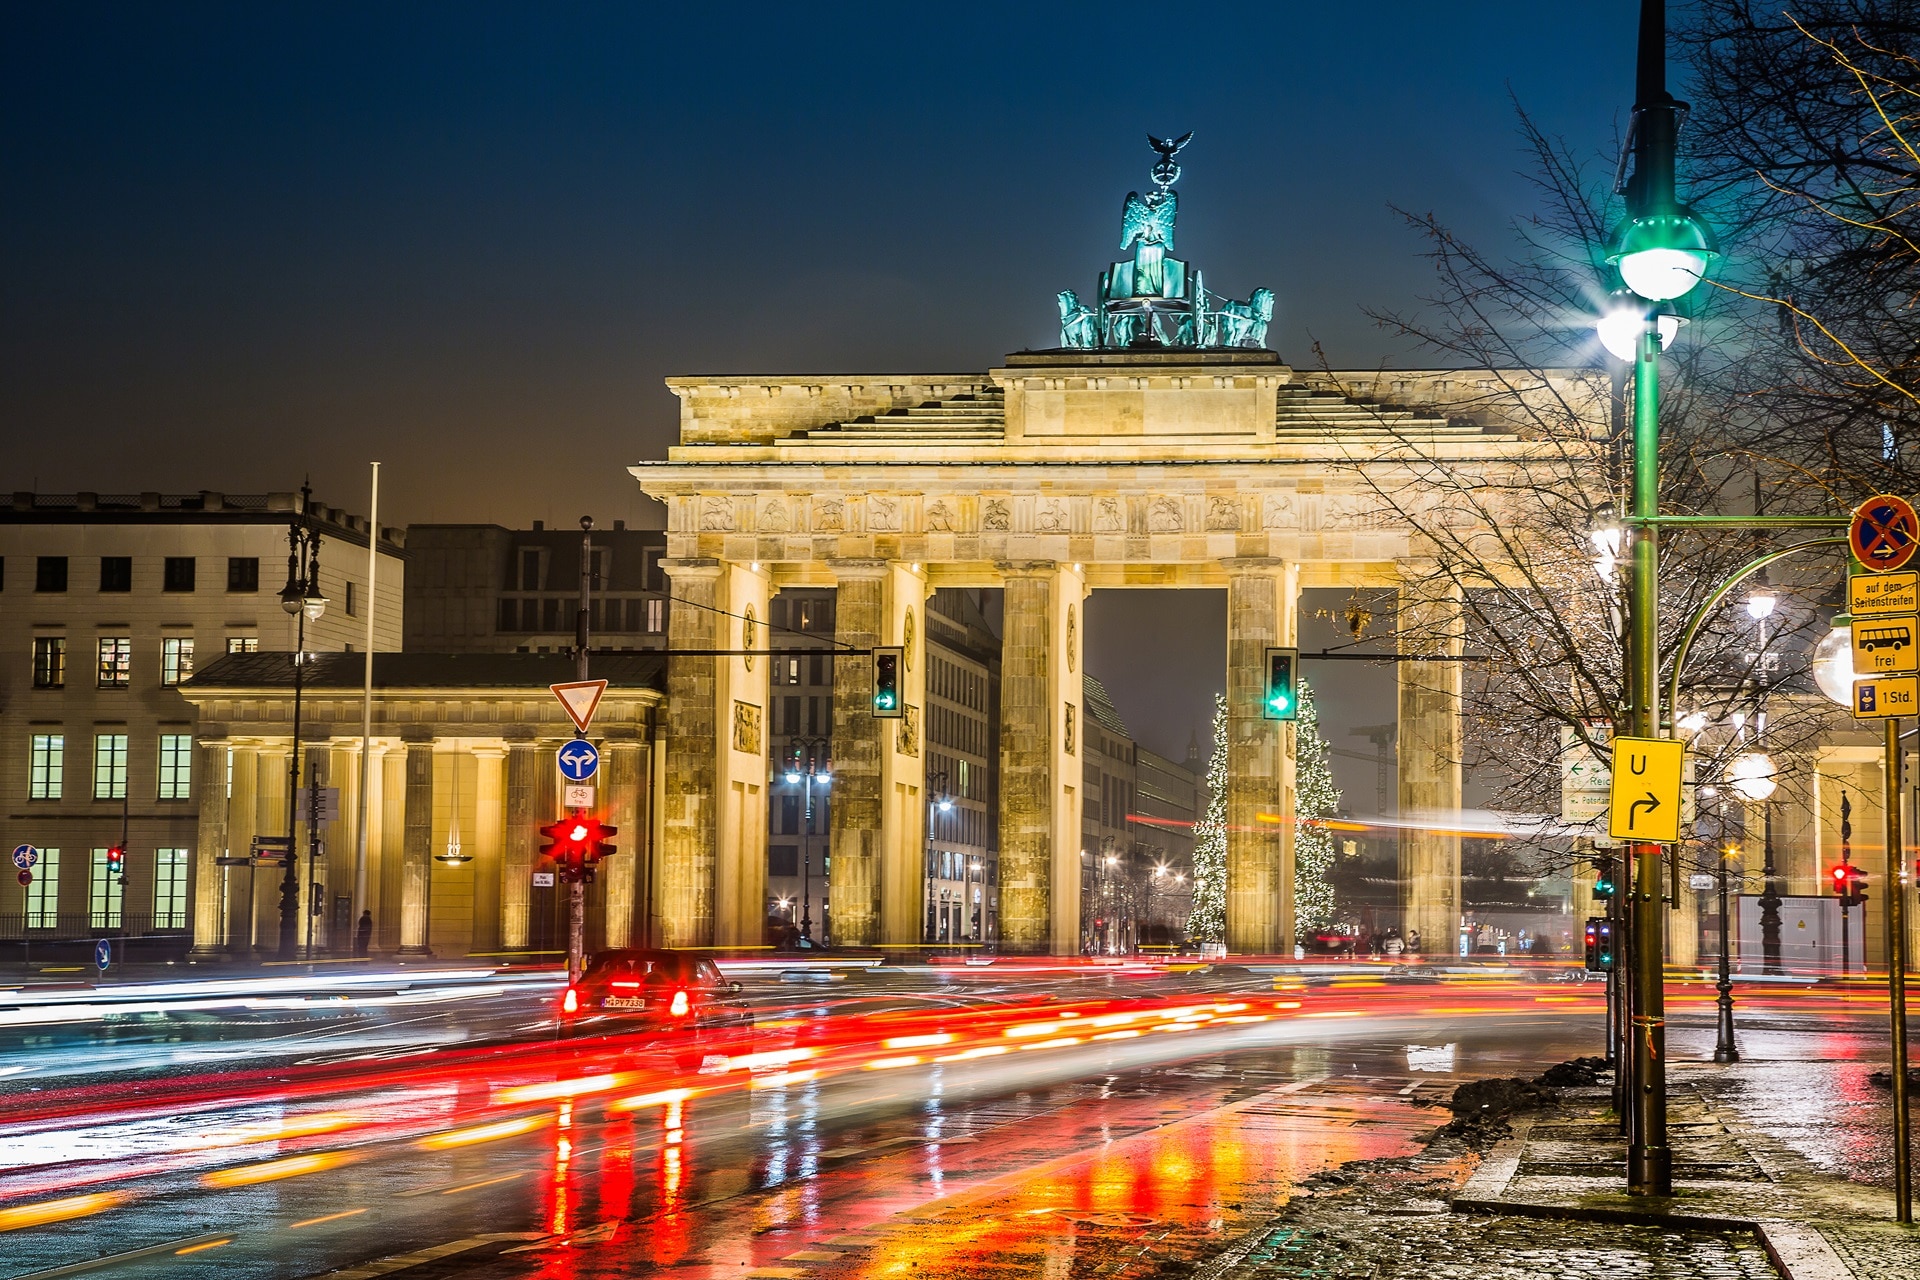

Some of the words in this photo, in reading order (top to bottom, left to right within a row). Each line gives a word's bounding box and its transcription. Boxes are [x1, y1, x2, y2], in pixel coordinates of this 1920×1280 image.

[1866, 582, 1879, 593] auf
[1884, 581, 1902, 592] dem
[1855, 595, 1913, 607] Seitenstreifen
[1875, 654, 1896, 667] frei
[1883, 692, 1887, 704] 1
[1890, 690, 1912, 704] Std.
[1631, 754, 1646, 775] U
